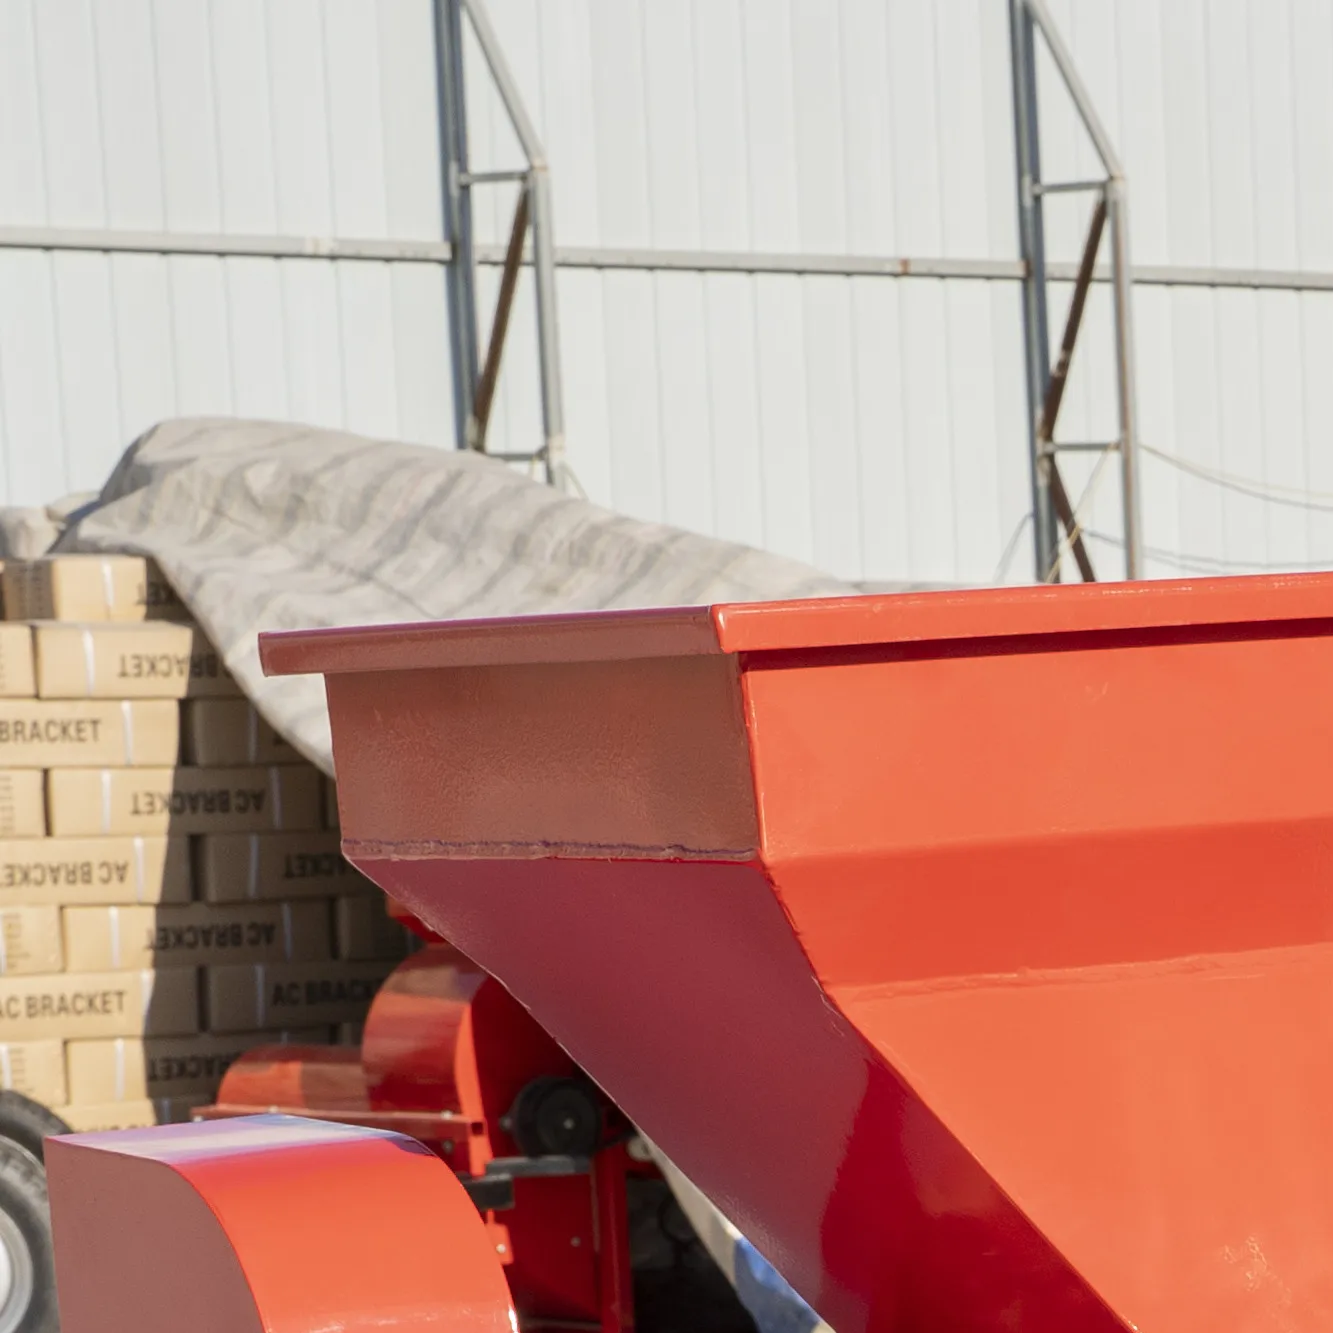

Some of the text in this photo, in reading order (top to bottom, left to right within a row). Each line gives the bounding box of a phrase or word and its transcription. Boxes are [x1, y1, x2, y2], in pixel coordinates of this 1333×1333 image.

[0, 718, 102, 744] BRACKET
[131, 789, 266, 815] AC BRACKET
[0, 861, 129, 888] AC BRACKE
[145, 922, 276, 951] AC BRACKET
[25, 990, 127, 1018] BRACKET
